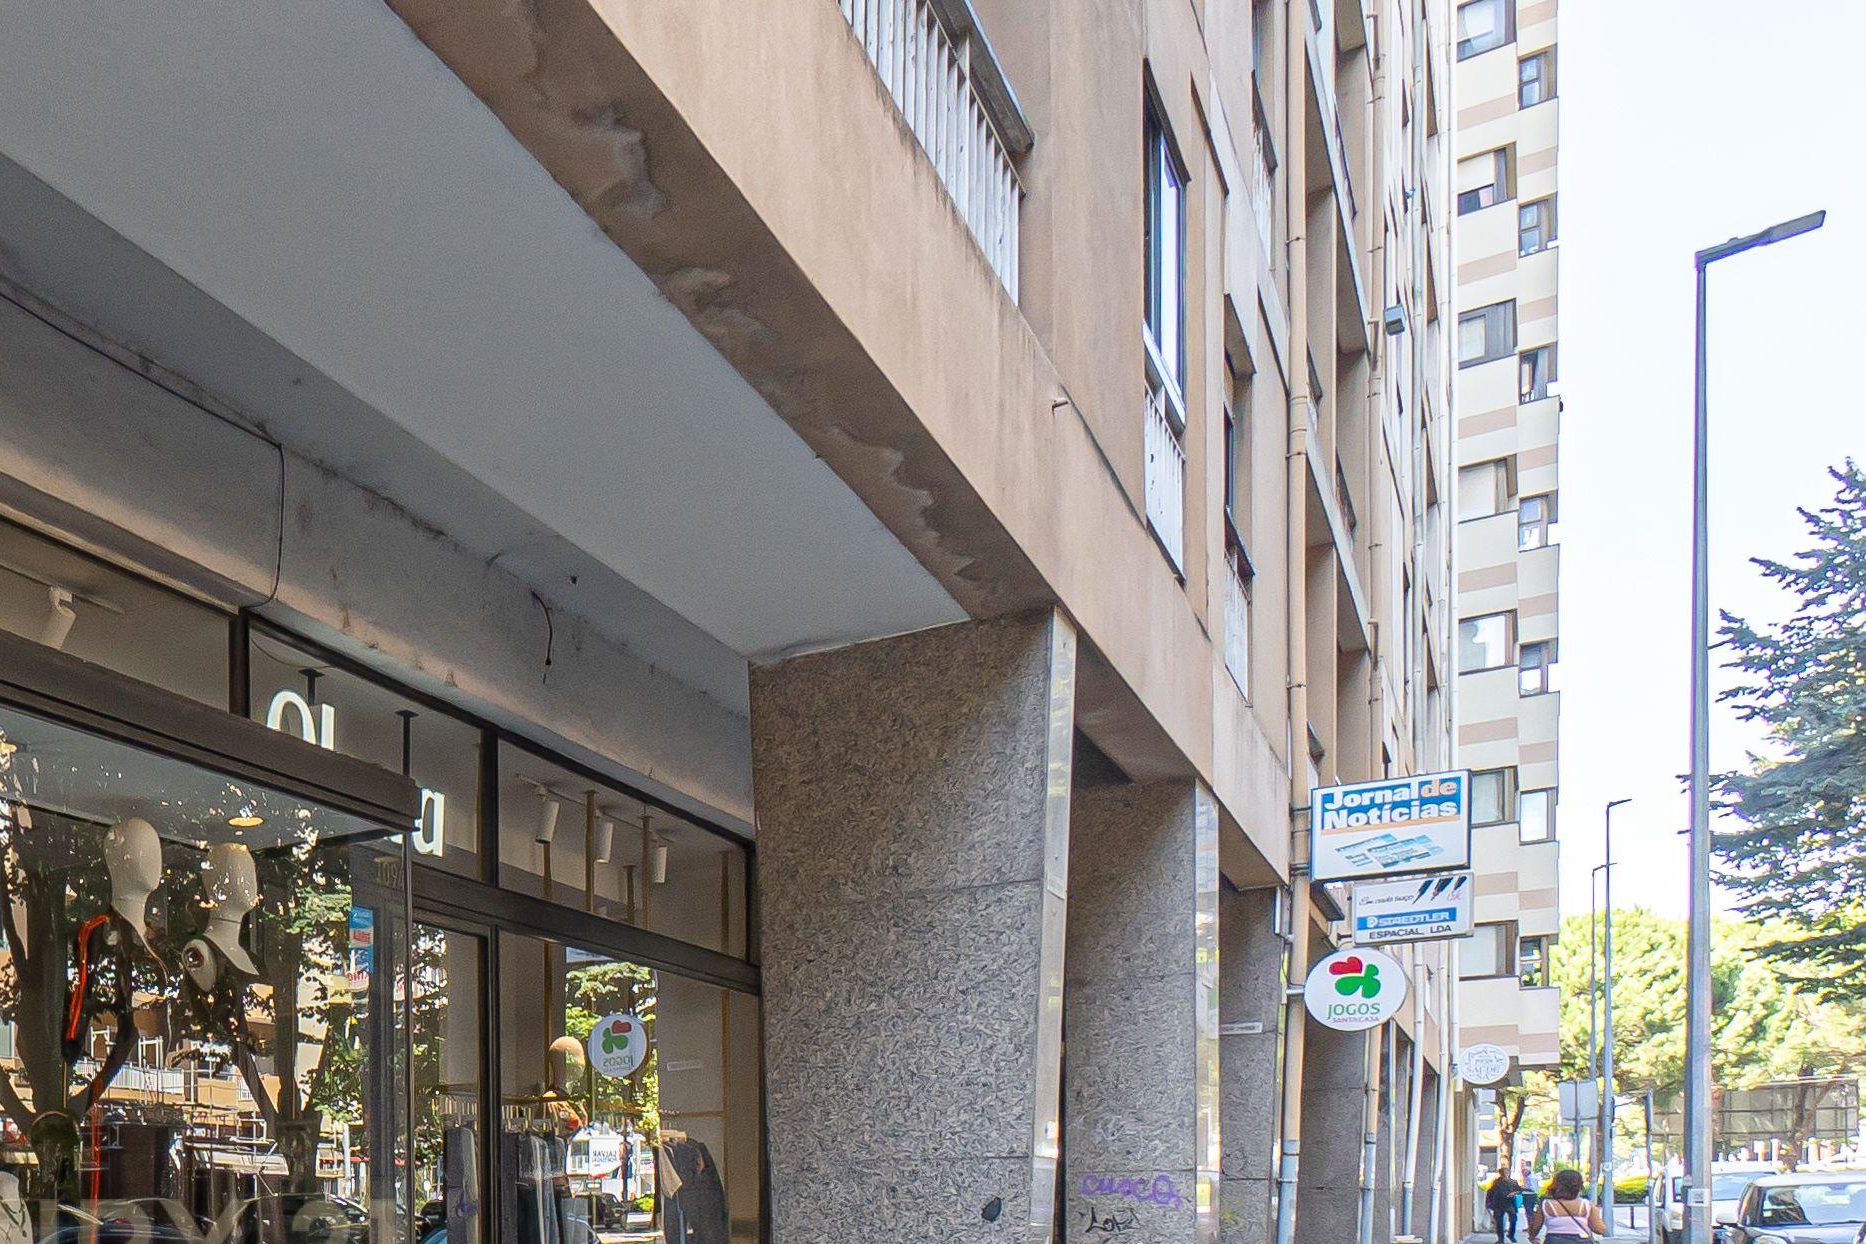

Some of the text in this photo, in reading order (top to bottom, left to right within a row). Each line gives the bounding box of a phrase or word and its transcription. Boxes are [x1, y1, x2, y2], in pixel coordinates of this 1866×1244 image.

[1324, 779, 1458, 810] Jornal de
[1323, 801, 1458, 830] Notícias
[1430, 924, 1452, 935] LDA
[1327, 1002, 1381, 1020] JOGOS
